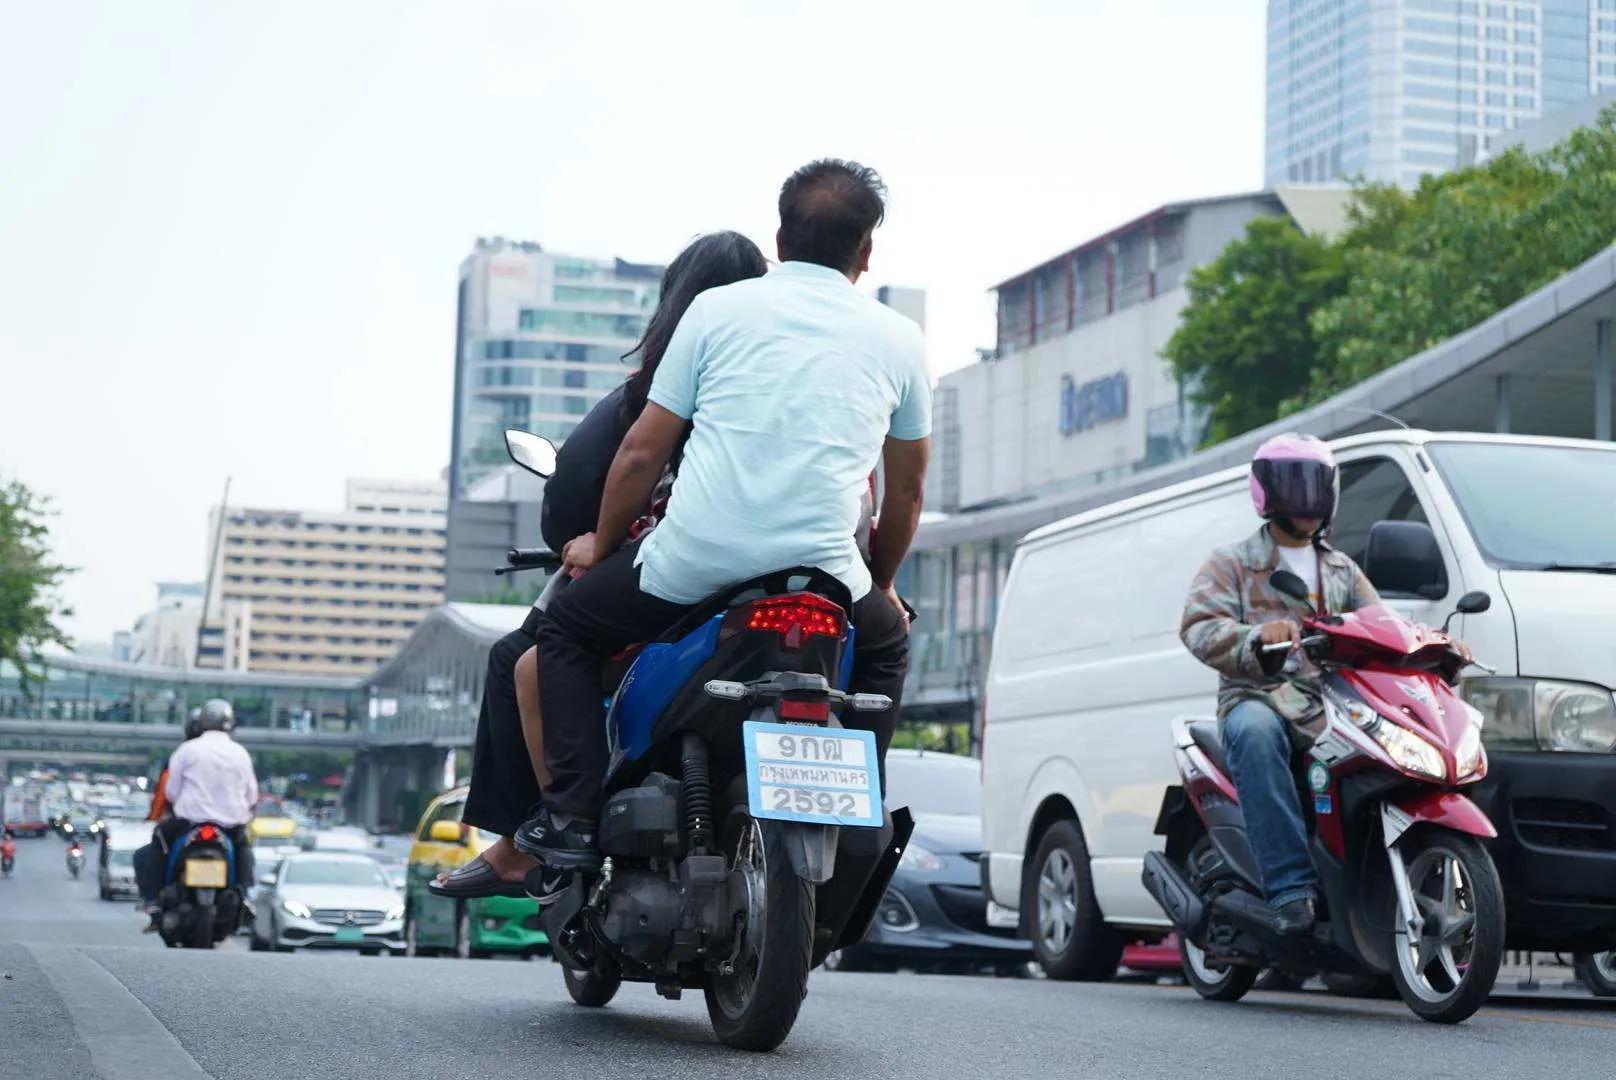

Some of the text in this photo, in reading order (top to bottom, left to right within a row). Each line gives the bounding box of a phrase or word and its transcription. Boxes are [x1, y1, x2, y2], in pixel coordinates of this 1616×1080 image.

[760, 765, 866, 785] กรุงเทพมหานคร
[773, 788, 857, 816] 2592
